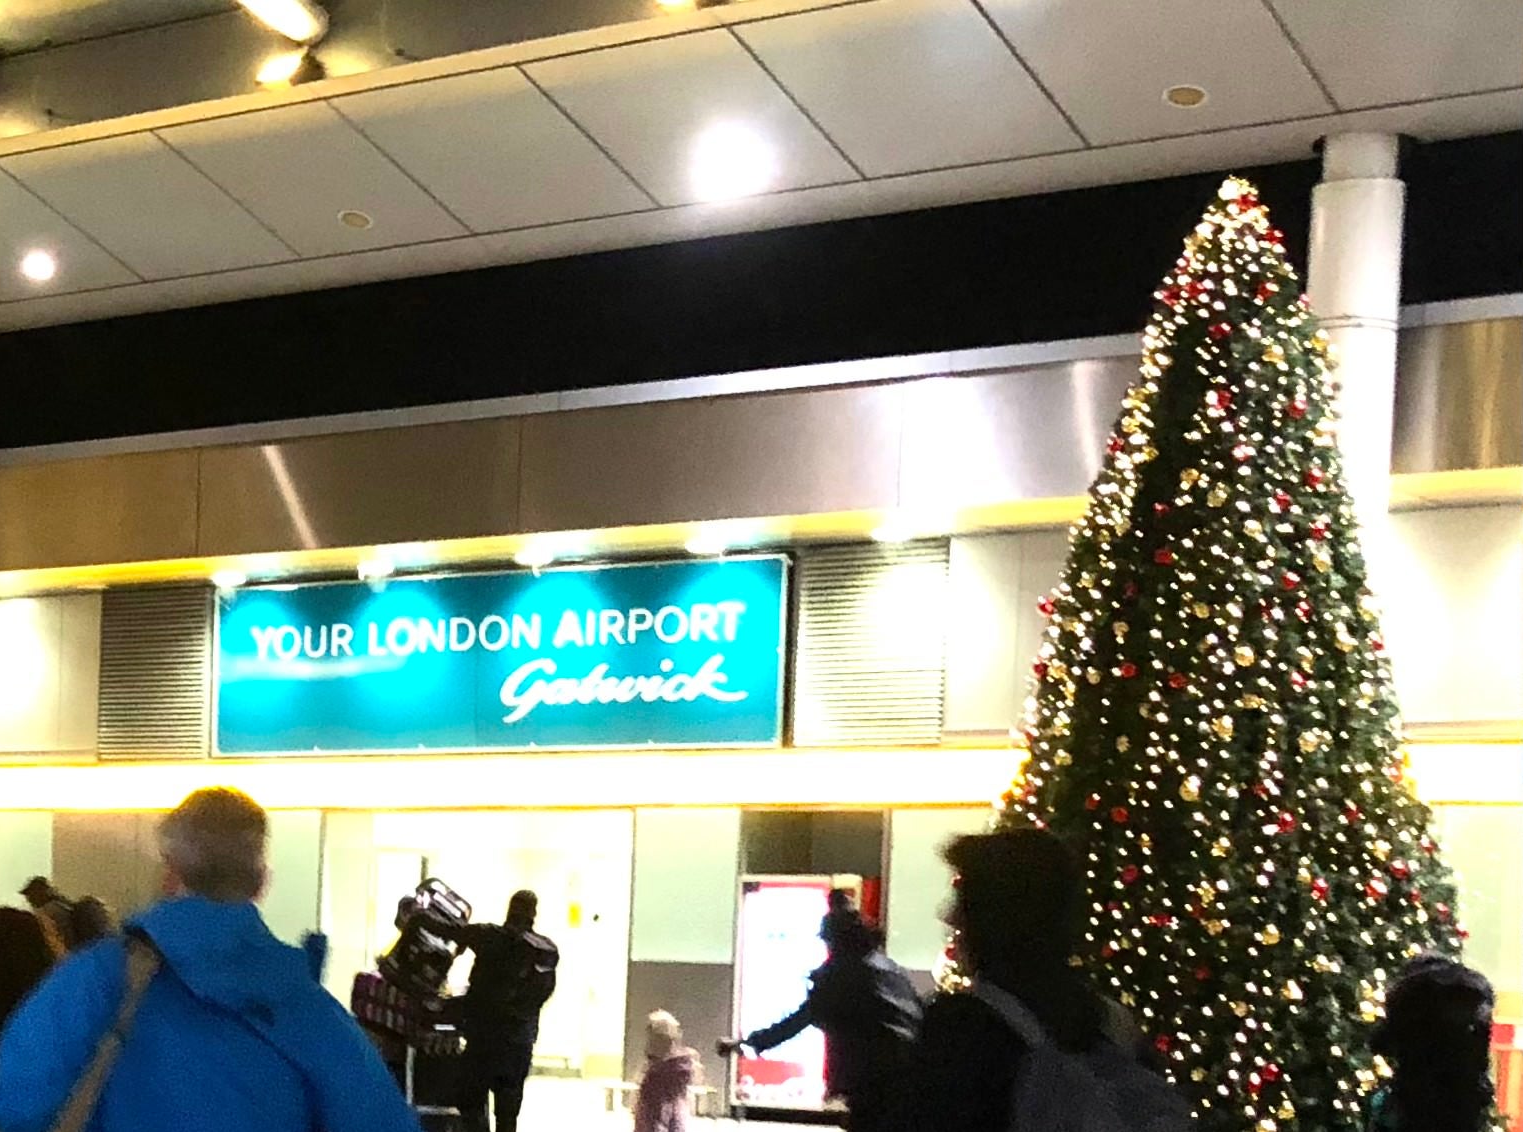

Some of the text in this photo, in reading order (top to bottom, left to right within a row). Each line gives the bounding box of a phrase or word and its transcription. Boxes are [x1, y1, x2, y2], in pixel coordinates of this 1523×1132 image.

[250, 600, 746, 661] YOUR LONDON AIRPORT
[499, 653, 749, 724] Gatwick
